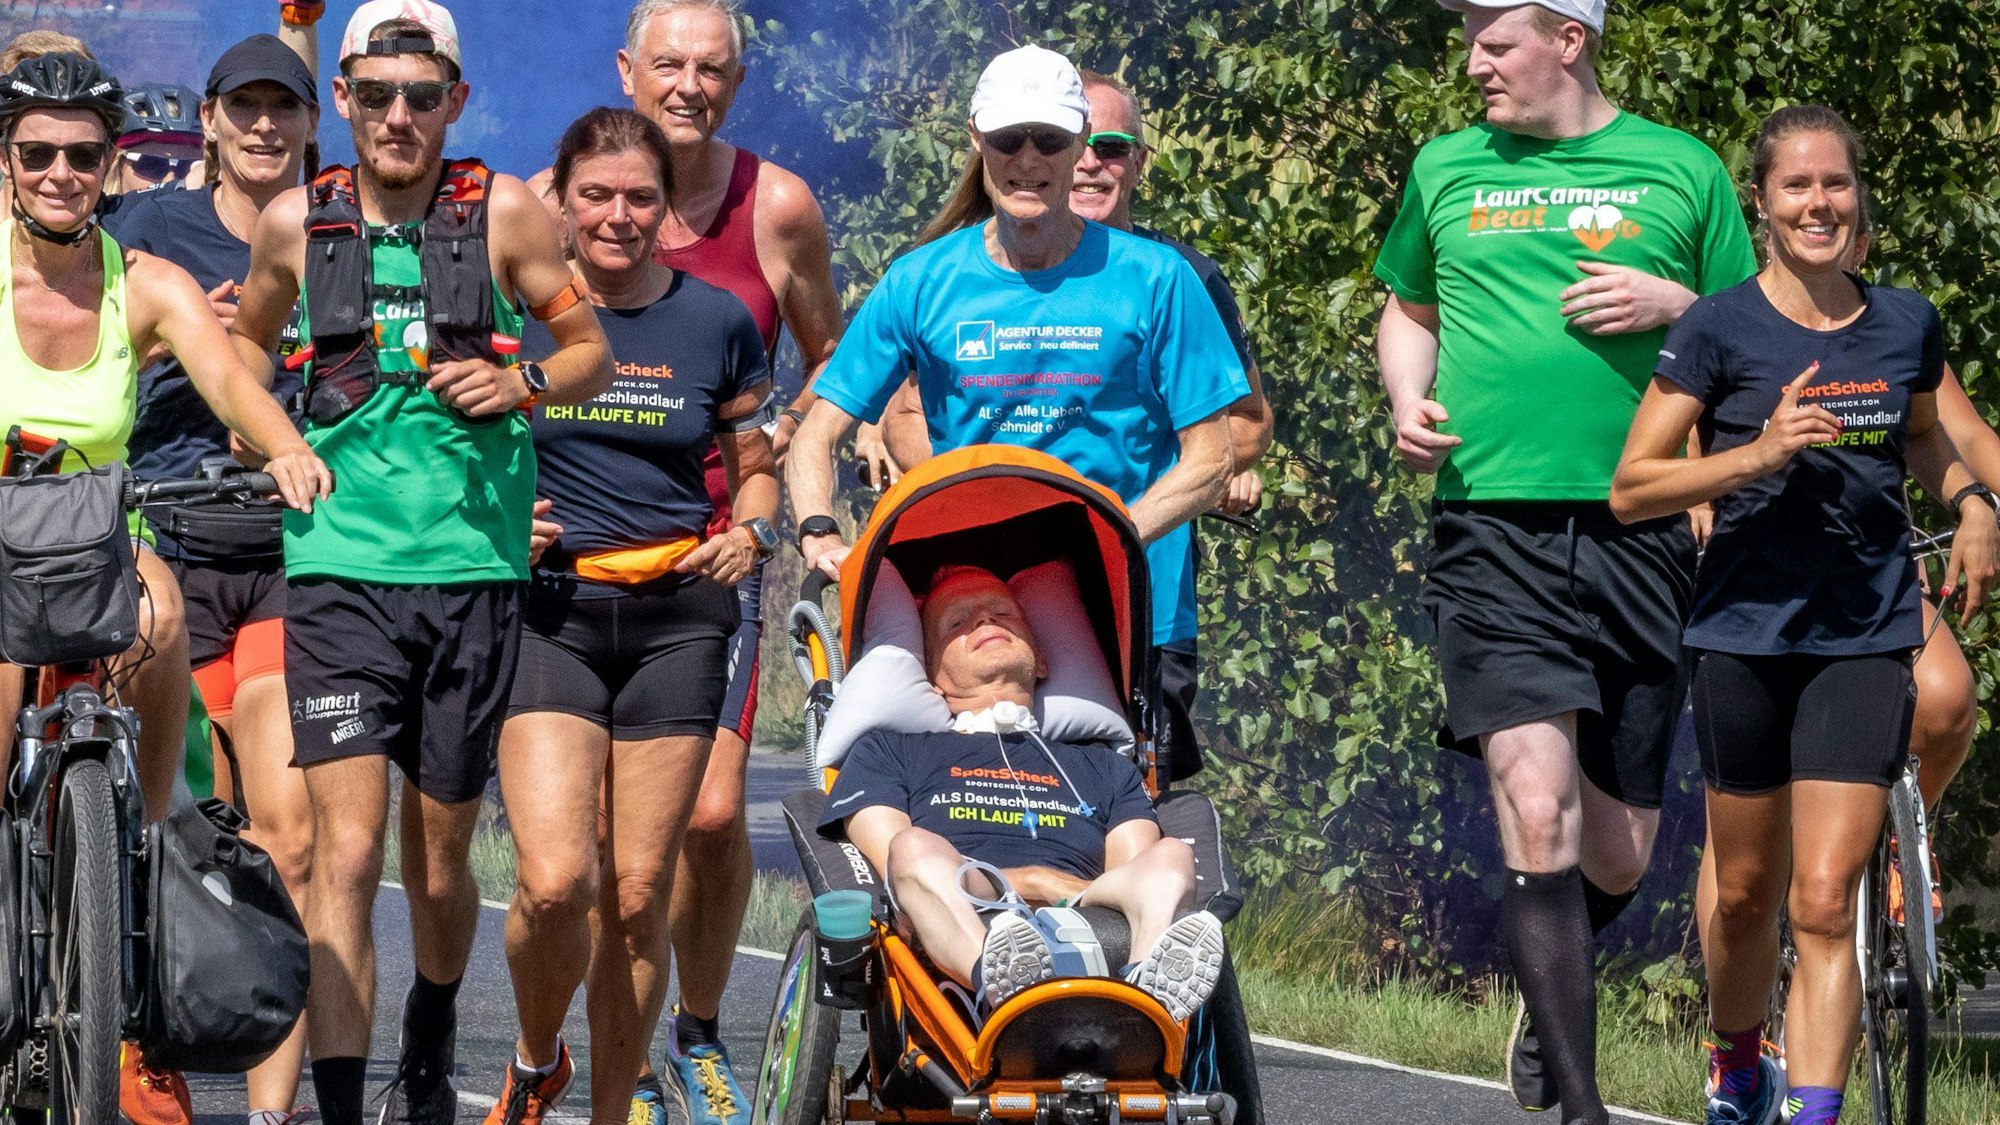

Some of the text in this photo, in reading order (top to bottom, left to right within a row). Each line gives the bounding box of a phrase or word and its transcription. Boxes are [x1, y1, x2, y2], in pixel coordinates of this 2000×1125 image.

[12, 80, 37, 97] uvex
[89, 82, 113, 97] uvex
[1468, 206, 1548, 232] Beat
[996, 326, 1103, 338] AGENTUR DECKER
[957, 340, 988, 356] AXA
[999, 341, 1099, 351] Service neu definiert
[960, 372, 1103, 388] SPENDENMARATHON
[545, 405, 667, 427] ICH LAUFE MIT
[978, 406, 1003, 420] ALS
[1014, 405, 1039, 418] Alle
[1041, 405, 1083, 418] Lieben
[991, 421, 1044, 434] Schmidt
[1862, 430, 1888, 445] MIT
[305, 691, 361, 714] bunert
[305, 708, 359, 720] Wuppertal
[331, 720, 366, 744] ANGER!
[950, 766, 1060, 788] SportScheck
[965, 780, 1048, 793] SPORTSCHECK.COM
[930, 792, 962, 806] ALS
[949, 806, 1066, 828] ICH LAUF MIT
